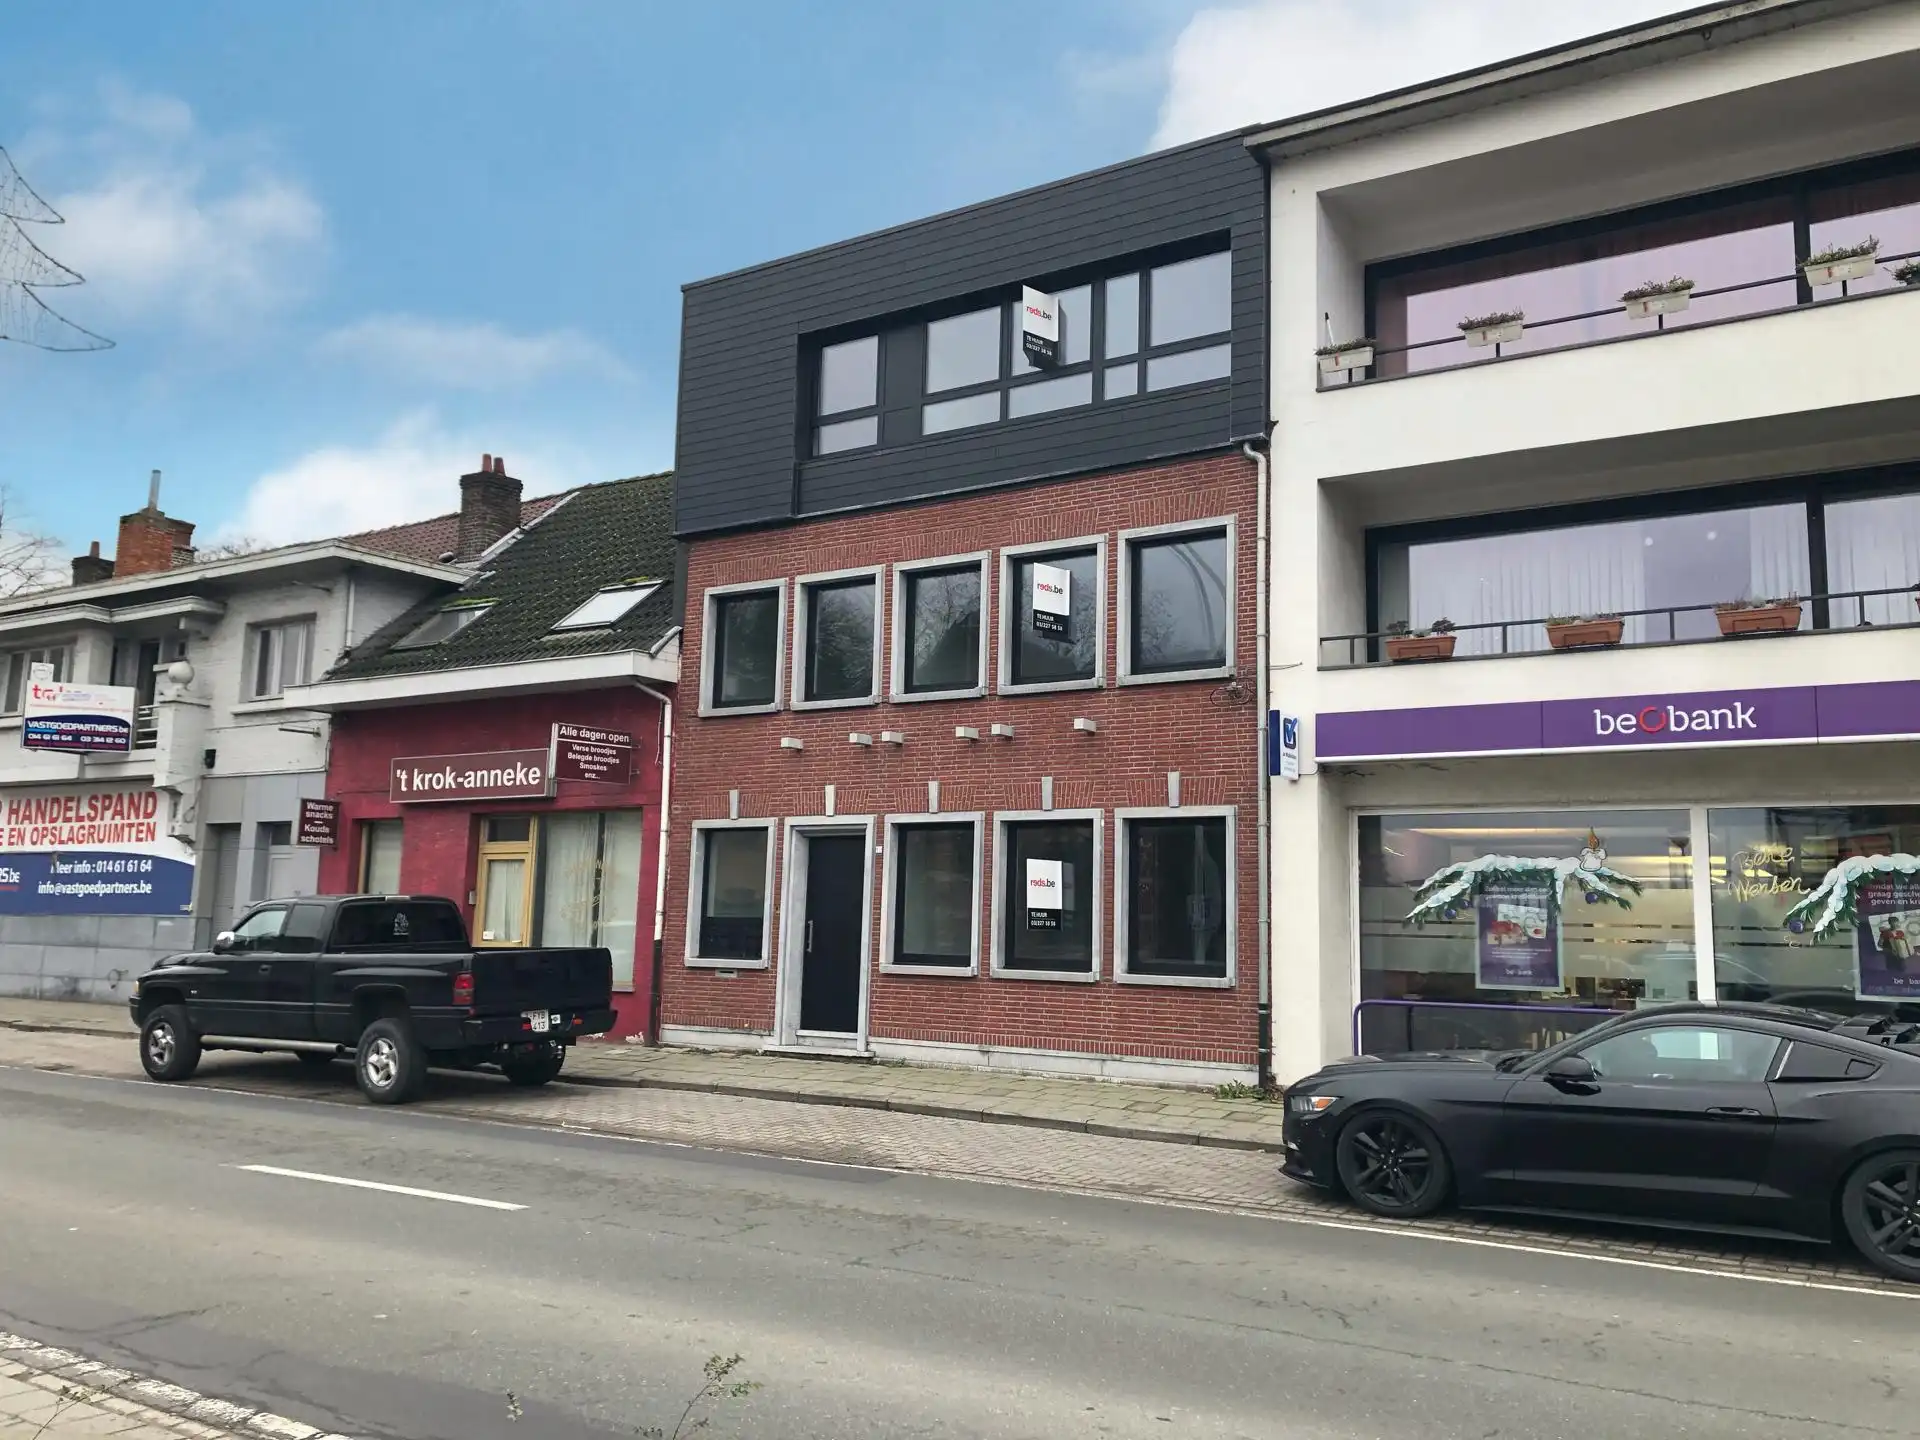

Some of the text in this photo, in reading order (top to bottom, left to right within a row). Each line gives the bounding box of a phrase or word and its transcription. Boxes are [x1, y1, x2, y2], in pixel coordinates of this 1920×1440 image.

[560, 726, 629, 743] Alle dagen open
[572, 743, 617, 755] Verse broodjes
[568, 752, 620, 765] Belegde broodjes
[579, 762, 607, 772] Smoskes
[396, 761, 541, 792] 't krok-anneke
[7, 791, 158, 825] HANDELSPAND
[306, 801, 334, 811] Warme
[305, 811, 333, 819] snacks
[304, 823, 330, 833] Koude
[7, 828, 26, 847] EN
[30, 822, 156, 846] OPSLAGRUIMTEN
[300, 835, 334, 844] schotels
[74, 860, 91, 874] info
[96, 860, 113, 873] 014
[114, 860, 125, 873] 61
[127, 860, 138, 873] 61
[140, 859, 152, 873] 64
[38, 880, 152, 897] info@vastgoedpartners.be
[1868, 891, 1891, 899] graag
